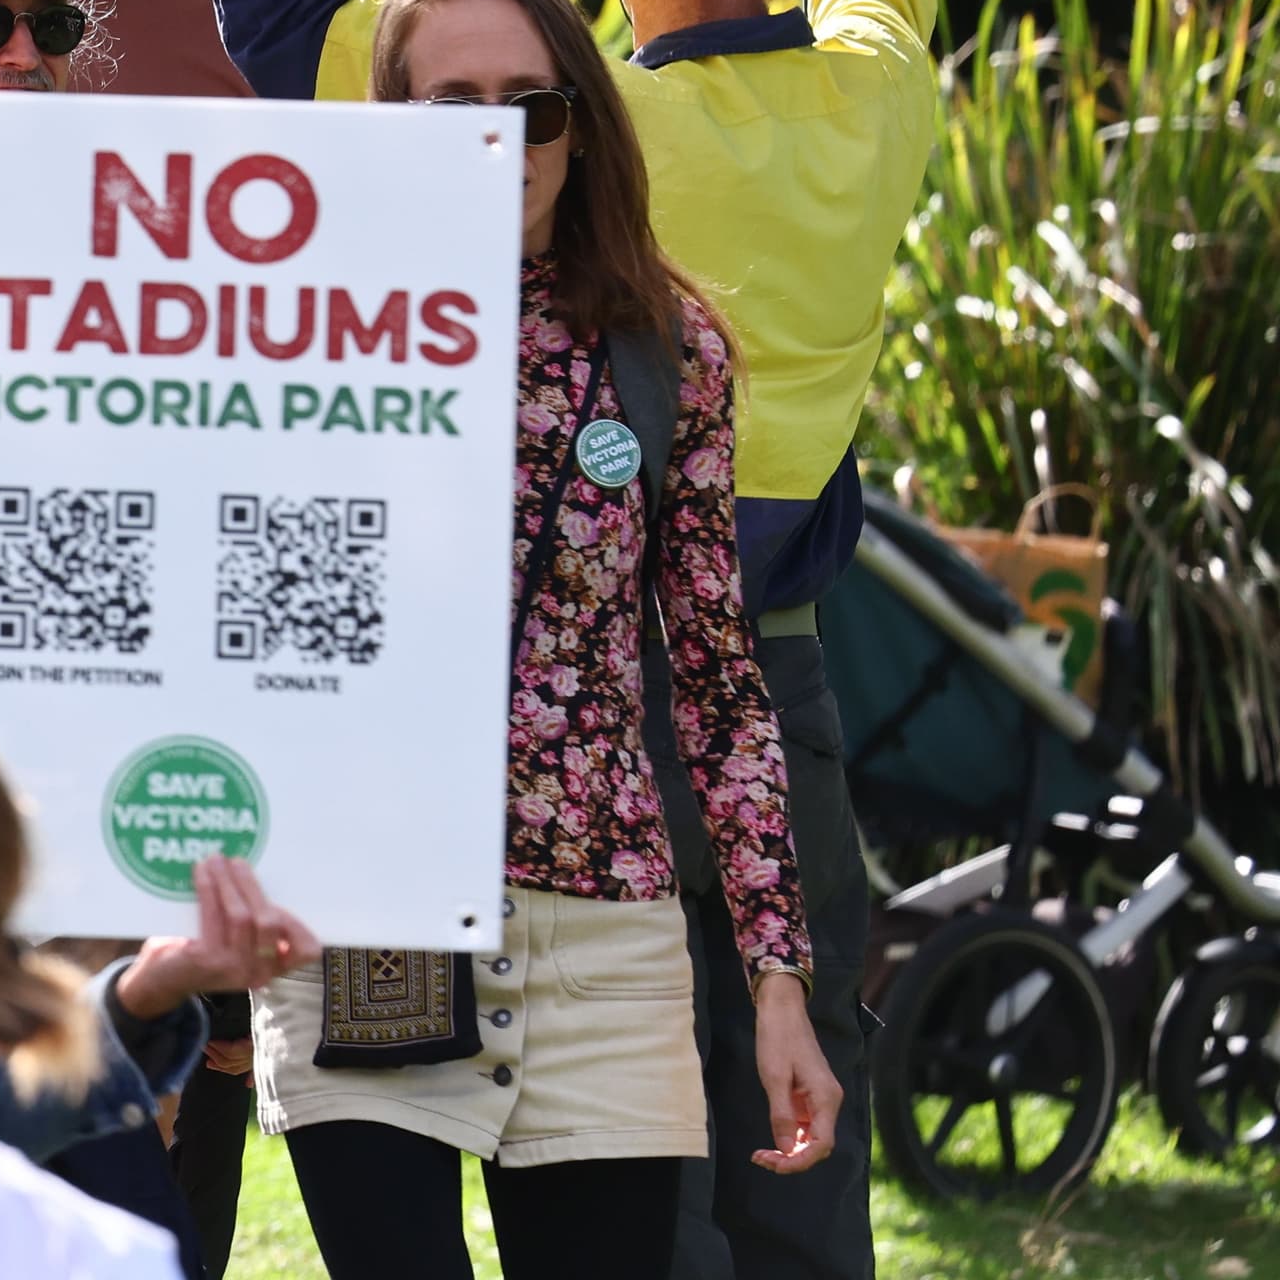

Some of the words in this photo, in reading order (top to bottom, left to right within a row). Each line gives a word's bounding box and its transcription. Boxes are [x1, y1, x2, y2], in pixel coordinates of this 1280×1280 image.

[90, 151, 319, 265] NO
[281, 383, 462, 437] PARK
[582, 439, 637, 466] VICTORIA
[589, 430, 620, 449] SAVE
[599, 456, 631, 476] PARK
[254, 673, 342, 694] DONATE
[147, 772, 226, 800] SAVE
[113, 803, 258, 834] VICTORIA
